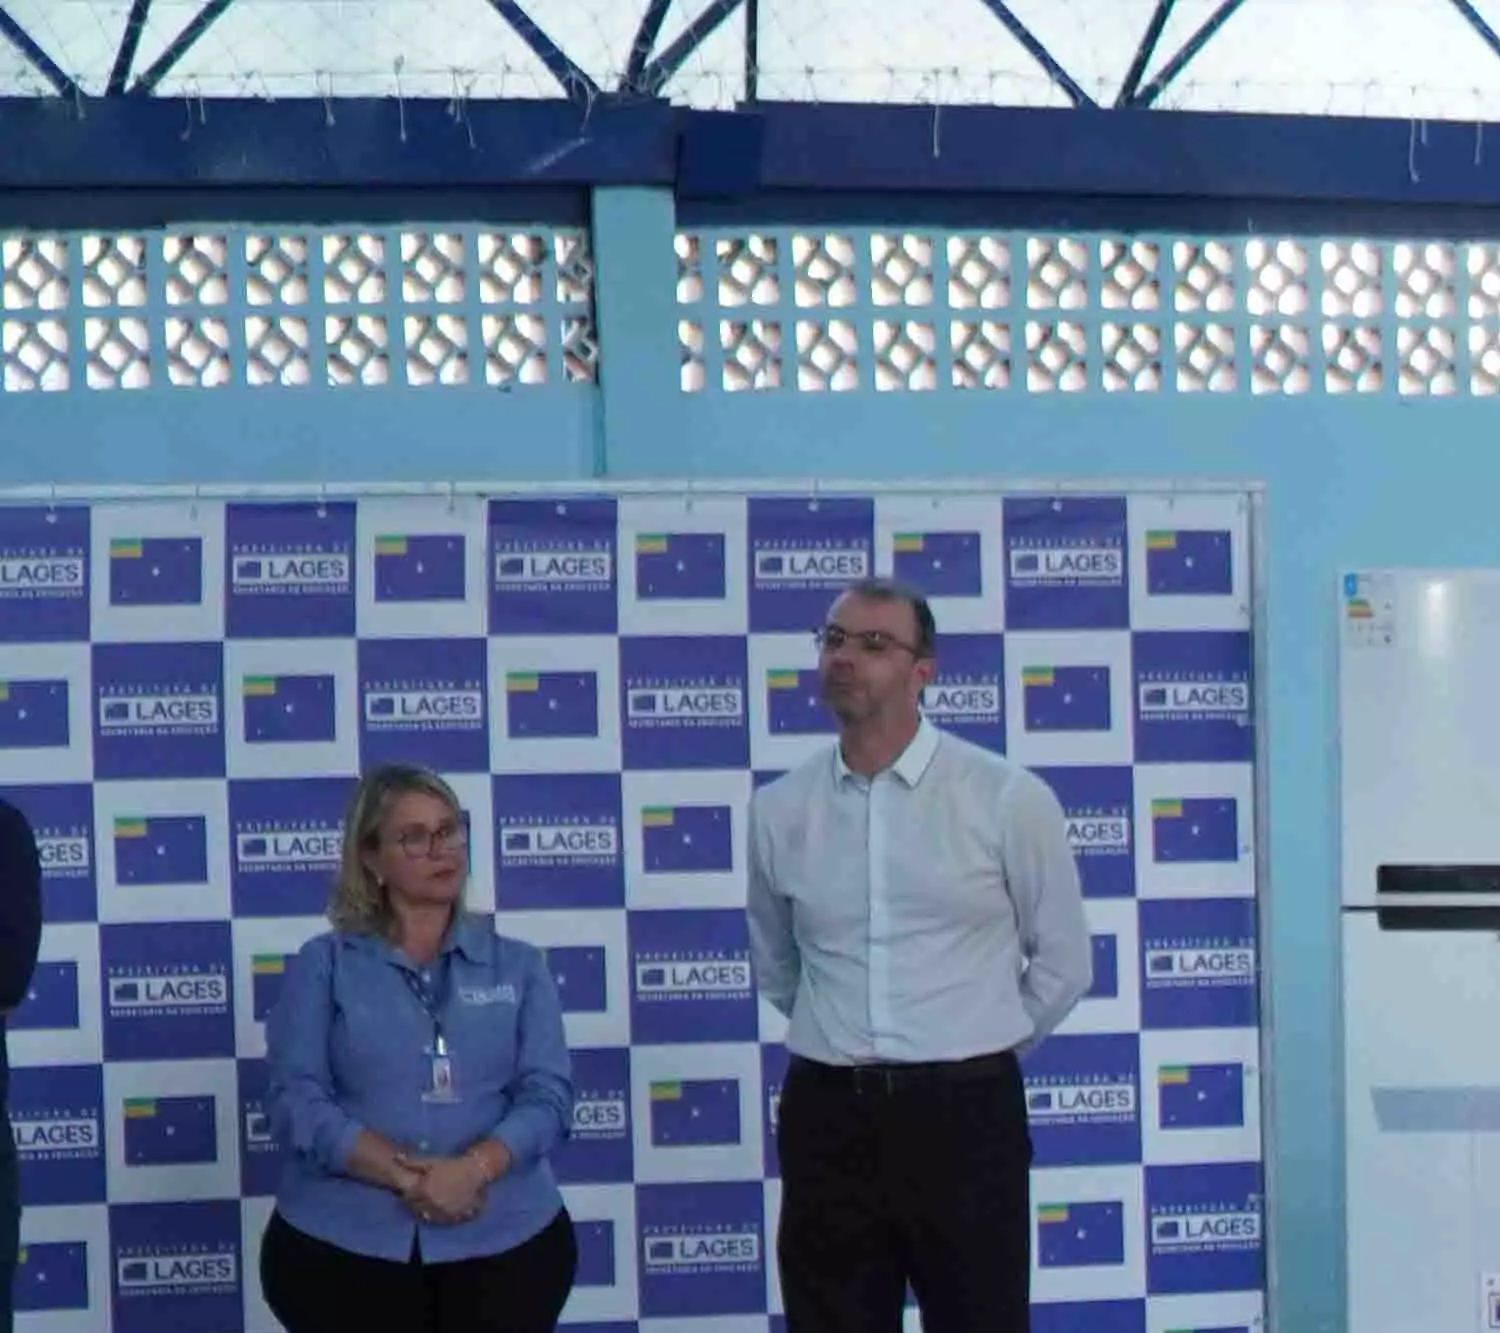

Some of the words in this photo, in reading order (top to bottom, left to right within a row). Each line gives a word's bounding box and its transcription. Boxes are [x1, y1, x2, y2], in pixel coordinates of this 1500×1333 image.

[2, 563, 78, 583] LAGES
[269, 559, 343, 578] LAGES
[532, 557, 605, 575] LAGES
[791, 555, 863, 574] LAGES
[1046, 554, 1117, 572] LAGES
[402, 695, 476, 715] LAGES
[664, 692, 736, 711] LAGES
[938, 690, 994, 708] AGES
[1173, 688, 1244, 705] LAGES
[137, 700, 212, 720] LAGES
[538, 830, 611, 850] LAGES
[1067, 822, 1123, 840] AGES
[33, 842, 83, 862] GES
[1180, 953, 1250, 972] LAGES
[672, 965, 745, 985] LAGES
[146, 980, 221, 1000] LAGES
[1059, 1089, 1129, 1109] LAGES
[576, 1105, 619, 1125] GES
[17, 1124, 93, 1145] LAGES
[1186, 1217, 1255, 1237] LAGES
[681, 1237, 753, 1258] LAGES
[155, 1258, 230, 1279] LAGES
